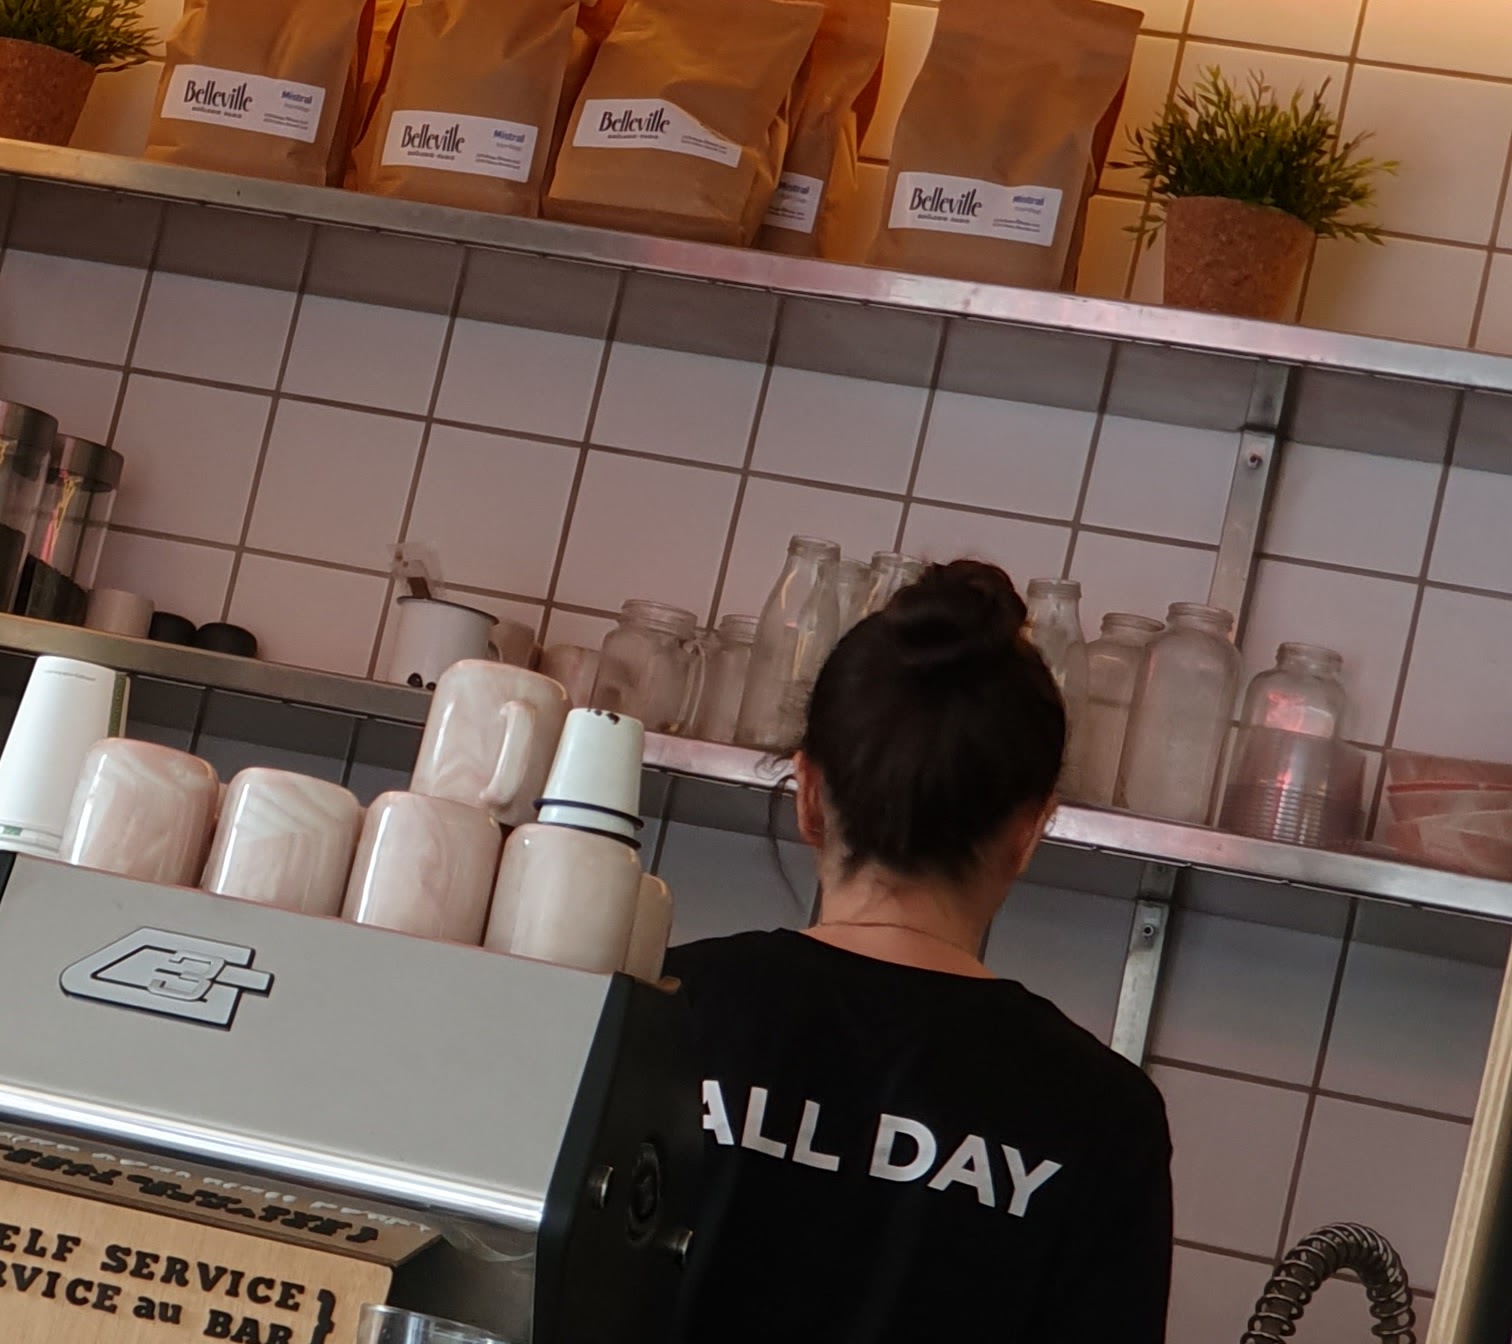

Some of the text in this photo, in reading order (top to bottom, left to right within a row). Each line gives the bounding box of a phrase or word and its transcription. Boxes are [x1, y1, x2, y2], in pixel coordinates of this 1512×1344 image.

[184, 79, 253, 112] Belleville
[599, 107, 670, 133] Belleville
[401, 124, 465, 153] Belleville
[910, 187, 982, 217] Belleville
[869, 1113, 1063, 1218] DAY
[101, 1244, 305, 1312] SERVICE
[132, 1293, 182, 1325] au
